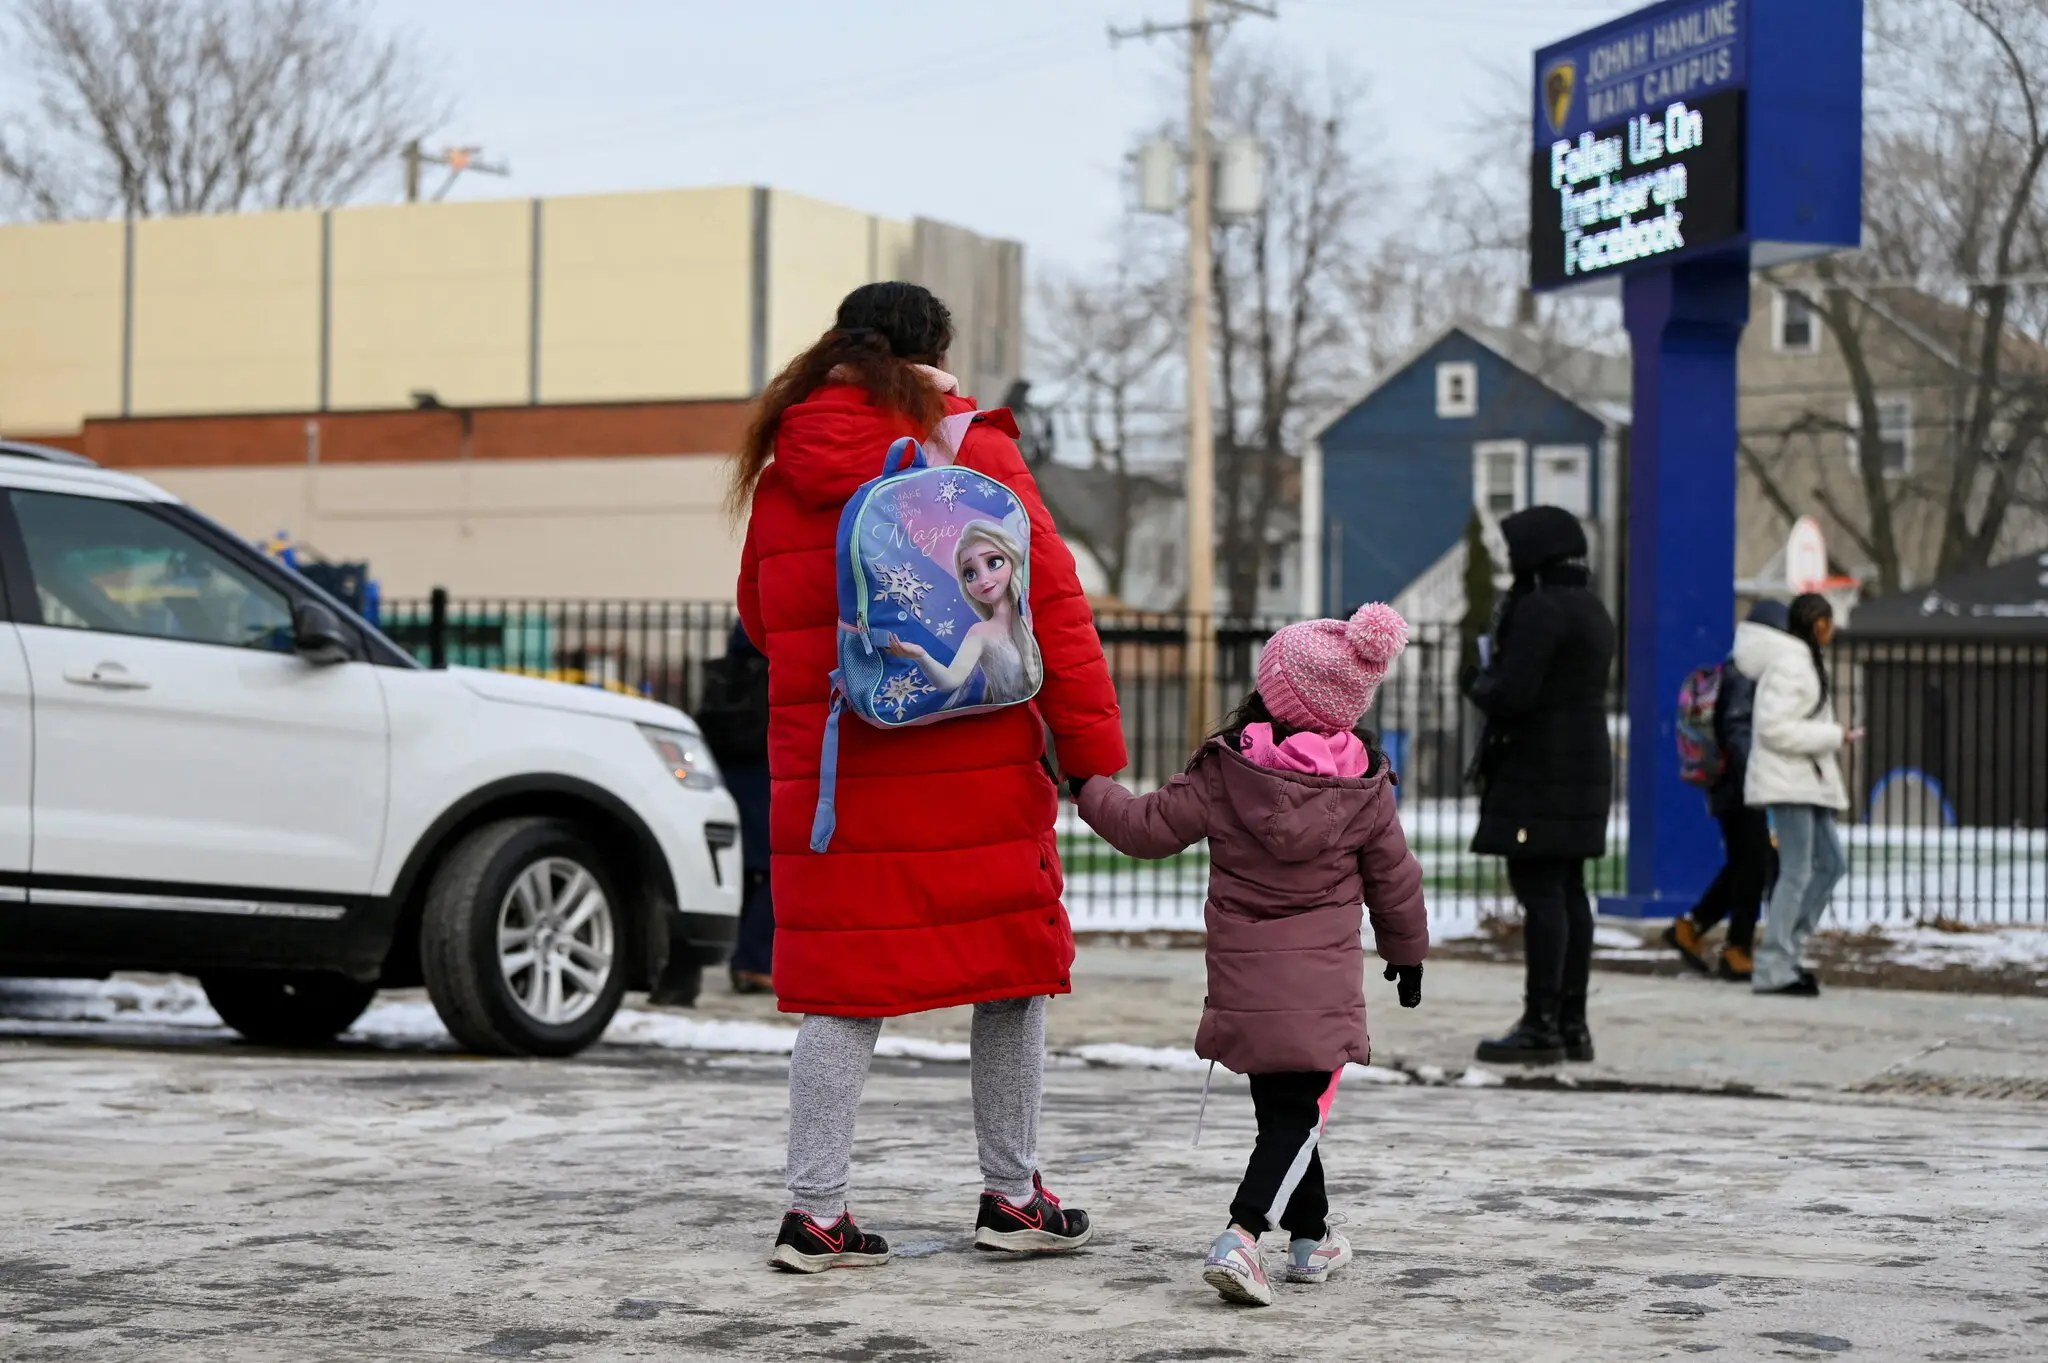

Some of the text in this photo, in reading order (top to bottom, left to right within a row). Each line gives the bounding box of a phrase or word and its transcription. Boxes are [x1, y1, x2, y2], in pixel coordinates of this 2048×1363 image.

[1585, 37, 1631, 85] JOHN
[1653, 0, 1738, 59] HAMLINE
[1588, 46, 1732, 123] MAIN CAMPUS
[1665, 101, 1703, 154] On
[1564, 202, 1685, 276] Facebook
[881, 501, 910, 513] YOUR
[892, 488, 921, 501] MAKE
[896, 507, 921, 519] OWN
[867, 519, 958, 560] Magic
